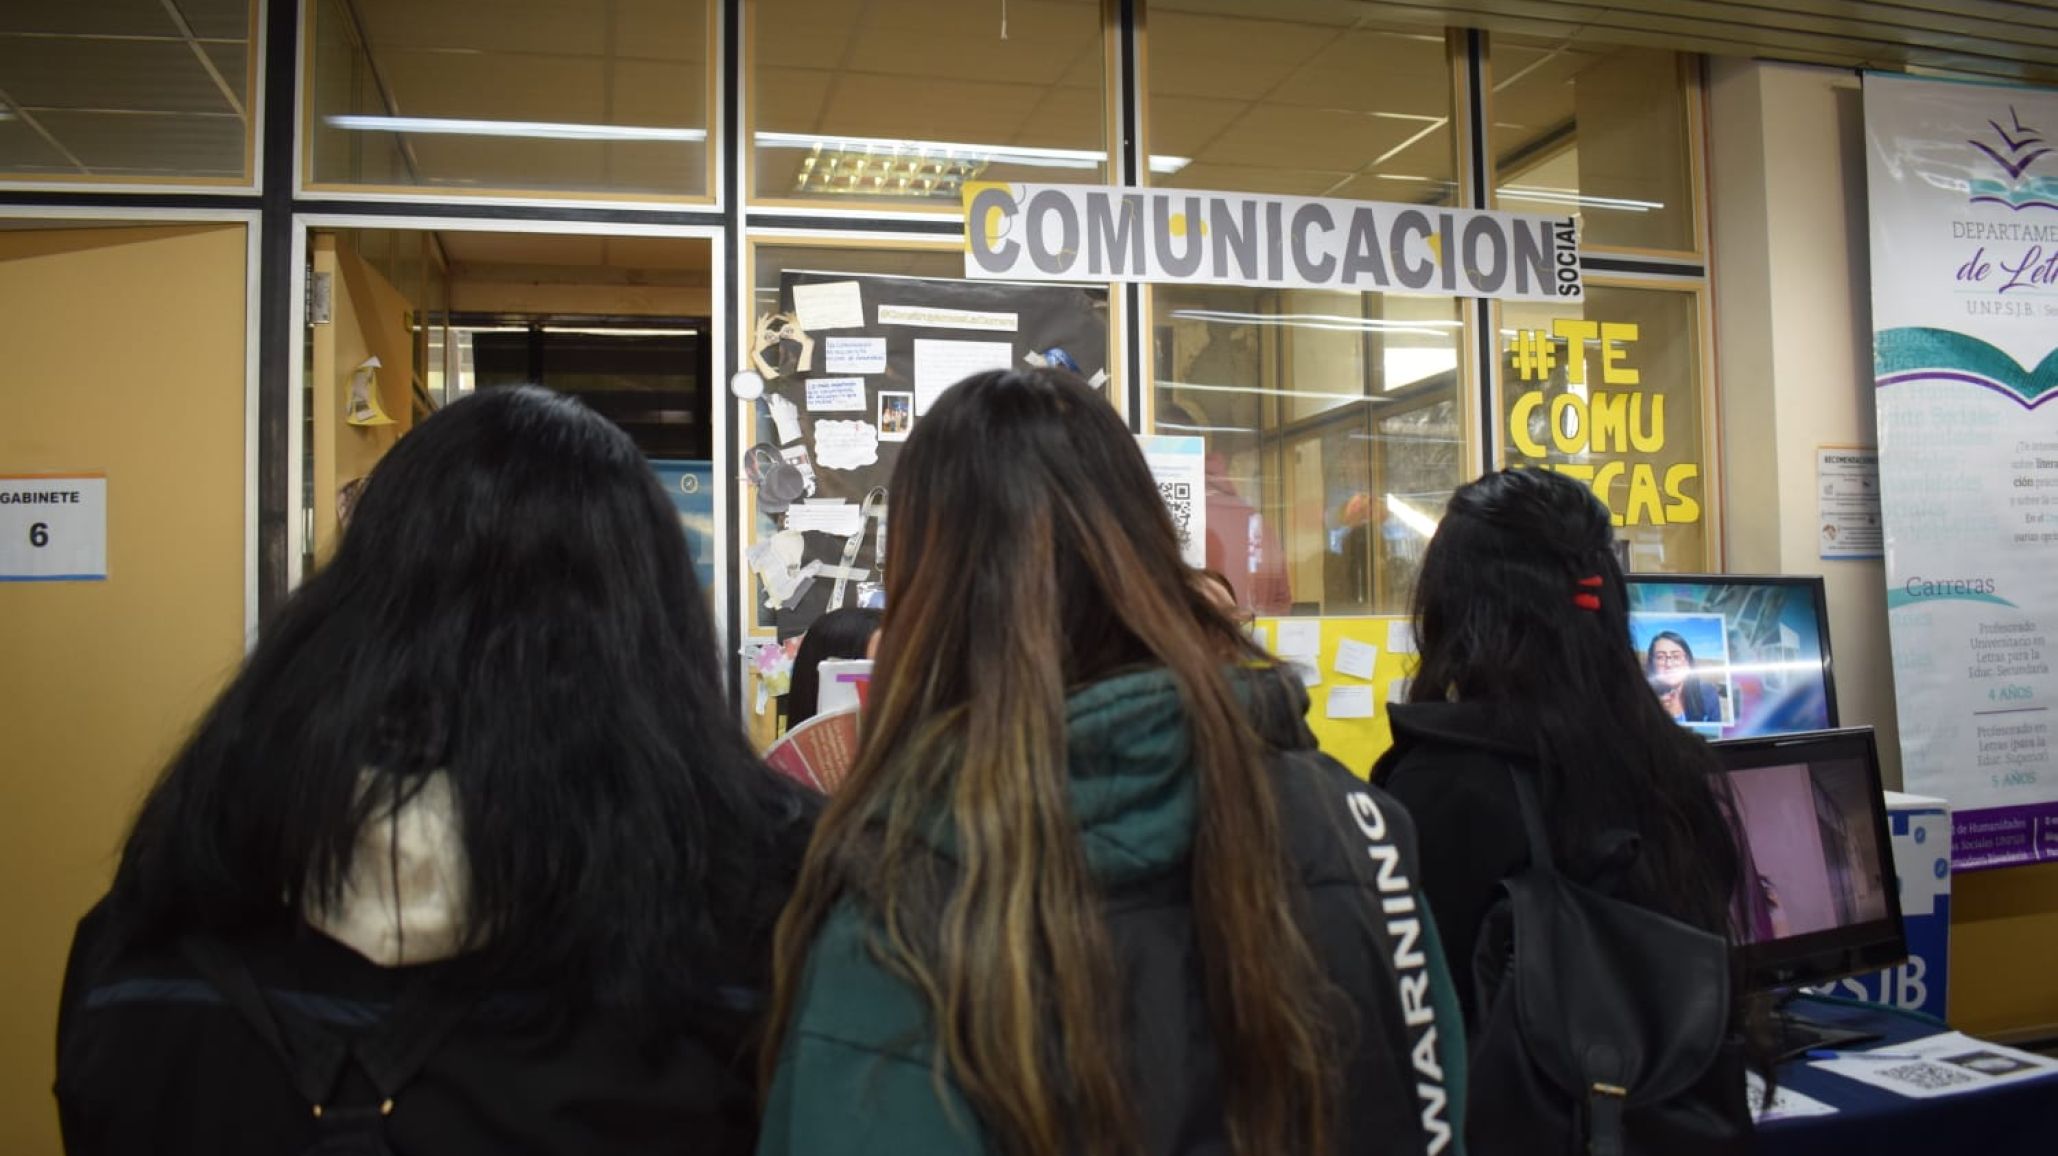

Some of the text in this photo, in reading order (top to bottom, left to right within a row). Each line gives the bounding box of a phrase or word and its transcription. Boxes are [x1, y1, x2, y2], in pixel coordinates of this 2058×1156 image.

[969, 186, 1580, 296] COMUNICACION SOCIAL
[1956, 246, 1991, 281] de
[1510, 318, 1640, 385] #TE
[1510, 390, 1665, 458] COMU
[0, 491, 80, 504] GABINETE
[1511, 460, 1700, 528] CAS
[29, 522, 49, 548] 6
[1906, 576, 1996, 597] Carreras
[1976, 652, 2005, 663] Letras
[1988, 684, 2033, 700] 4 AÑOS
[1347, 791, 1453, 1156] WARNING
